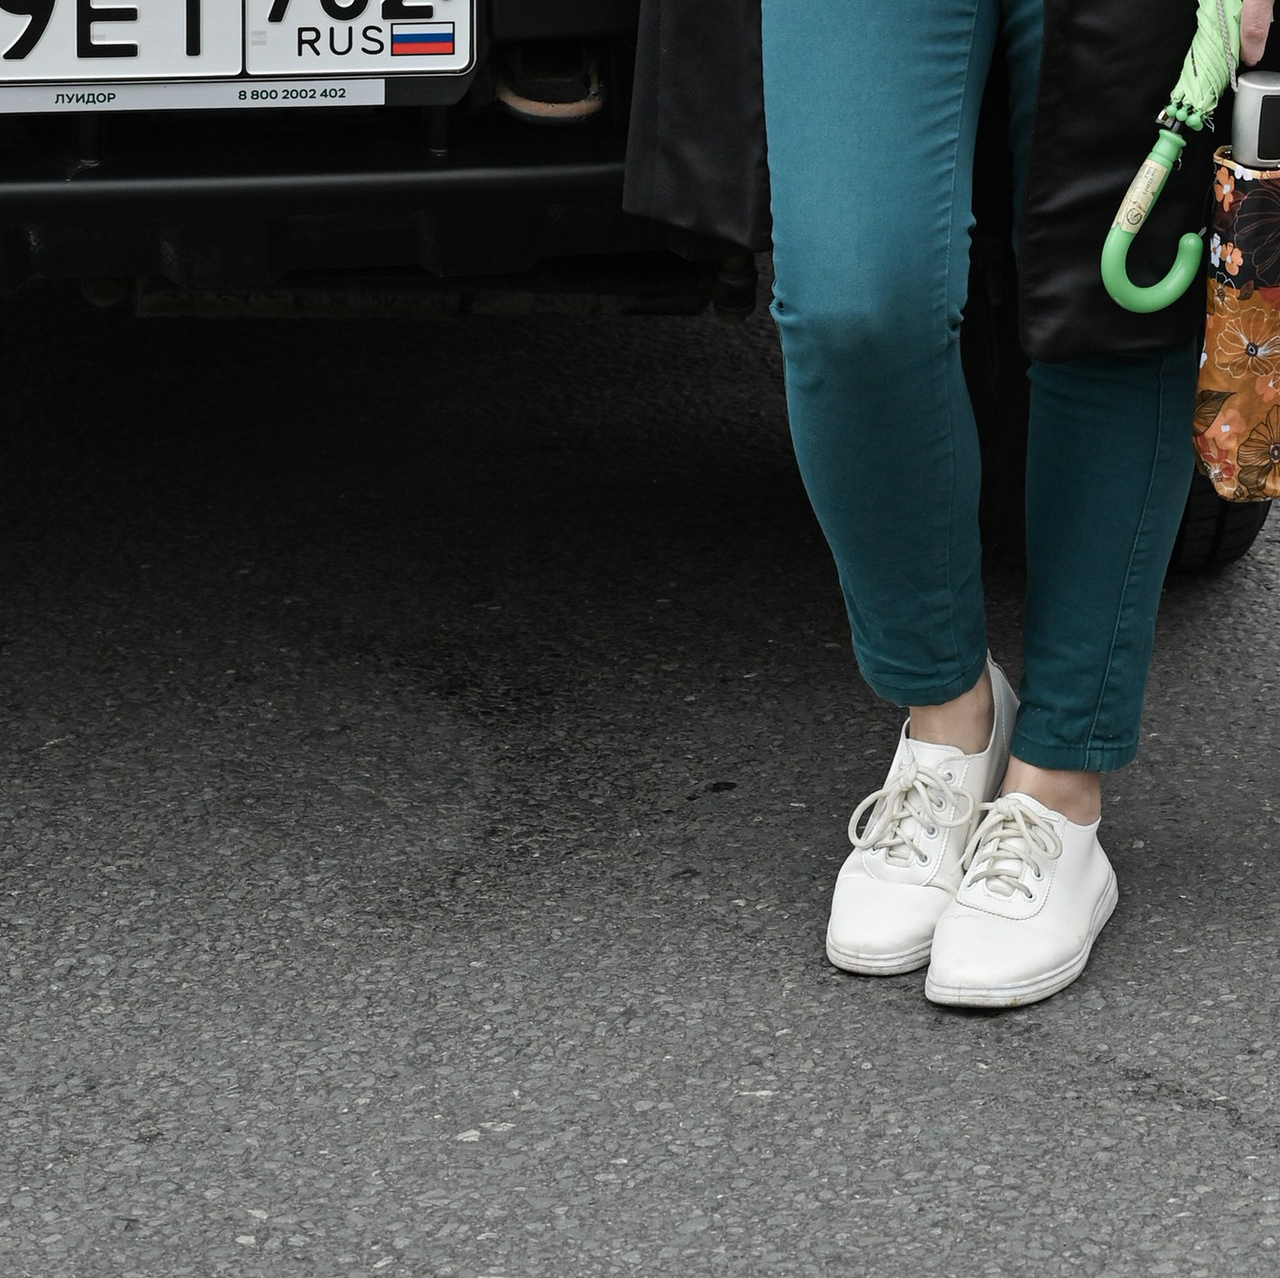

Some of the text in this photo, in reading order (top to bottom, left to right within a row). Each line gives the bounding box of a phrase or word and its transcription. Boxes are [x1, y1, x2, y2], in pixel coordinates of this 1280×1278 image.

[297, 25, 386, 57] RUS
[54, 88, 347, 106] ЛУИДОР 8 800 2002 402
